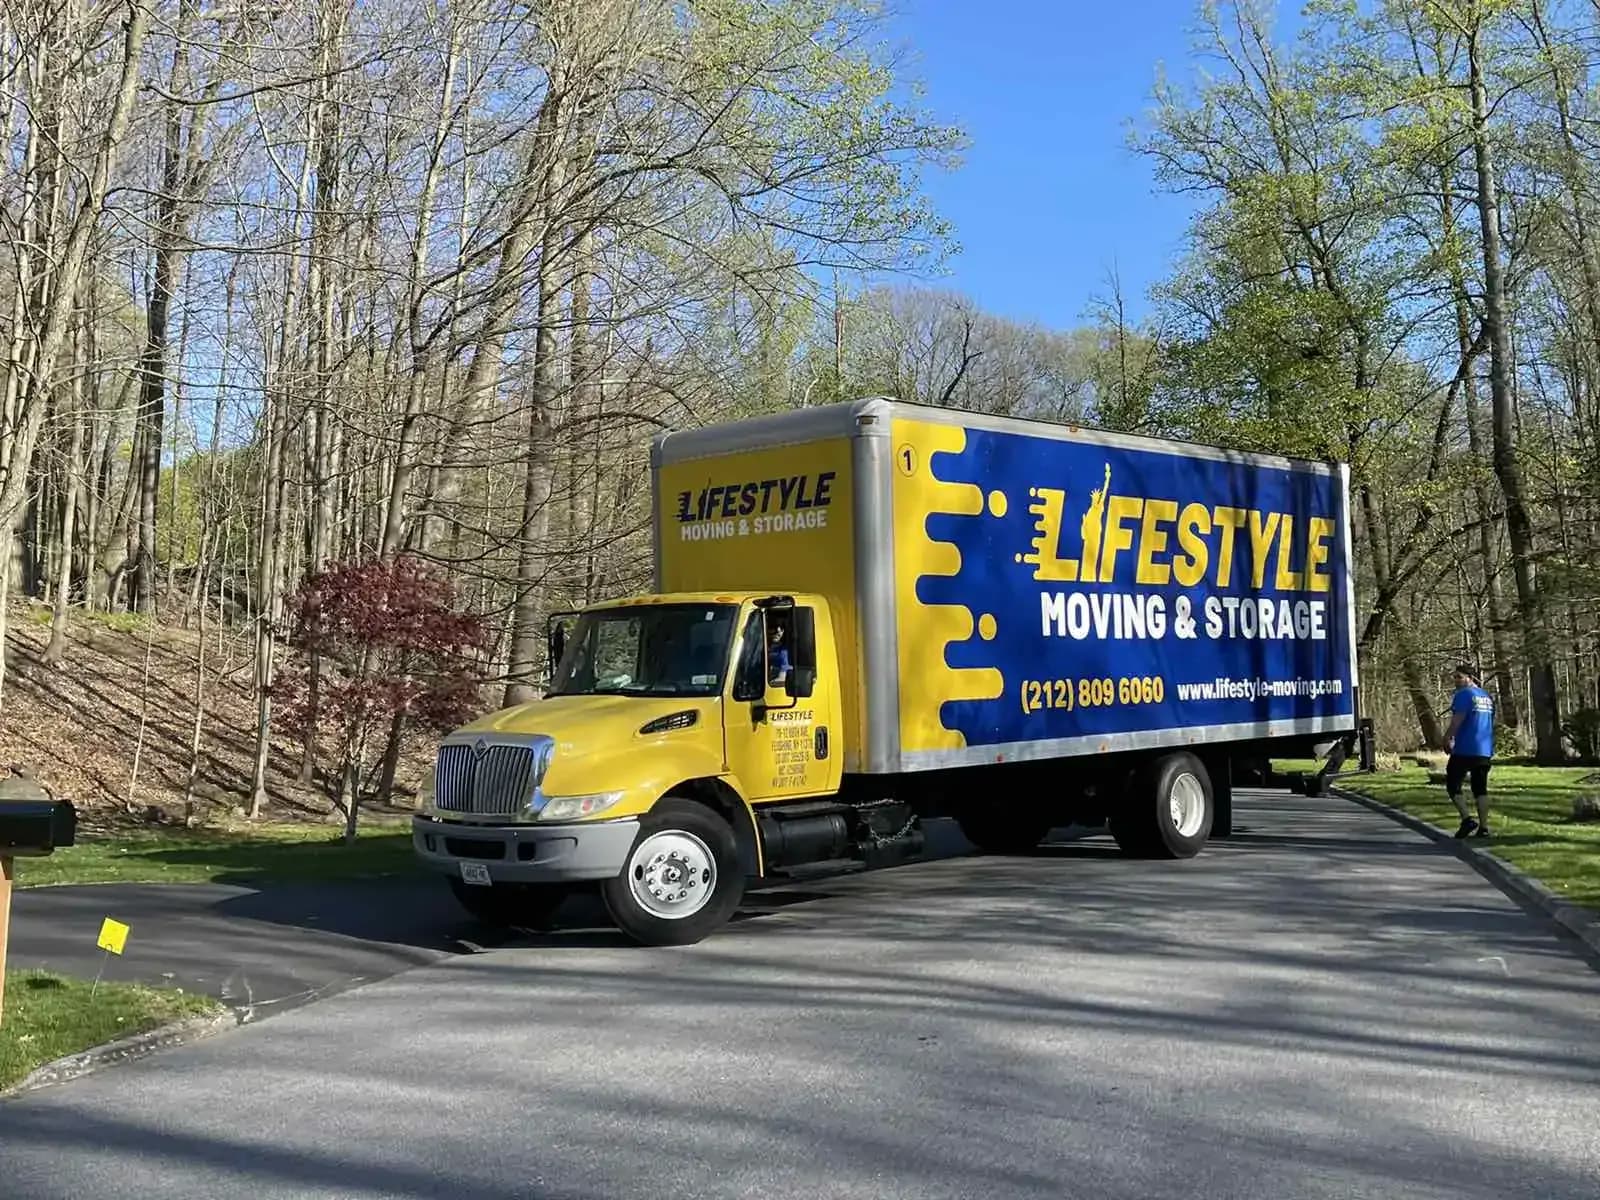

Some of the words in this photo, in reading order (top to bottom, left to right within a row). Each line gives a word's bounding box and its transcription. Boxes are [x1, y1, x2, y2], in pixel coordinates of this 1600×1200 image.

[903, 449, 911, 471] 1
[674, 472, 836, 523] LIFESTYLE
[681, 521, 735, 542] MOVING
[738, 519, 750, 536] &
[754, 510, 827, 535] STORAGE
[1025, 464, 1336, 593] LIFESTYLE
[1040, 591, 1166, 640] MOVING
[1174, 595, 1197, 640] &
[1204, 596, 1326, 640] STORAGE
[1021, 678, 1074, 714] (212)
[1078, 678, 1114, 707] 809
[1118, 676, 1164, 705] 6060
[1177, 676, 1342, 702] www.lifestyle-moving.com
[771, 710, 813, 721] LIFESTYLE
